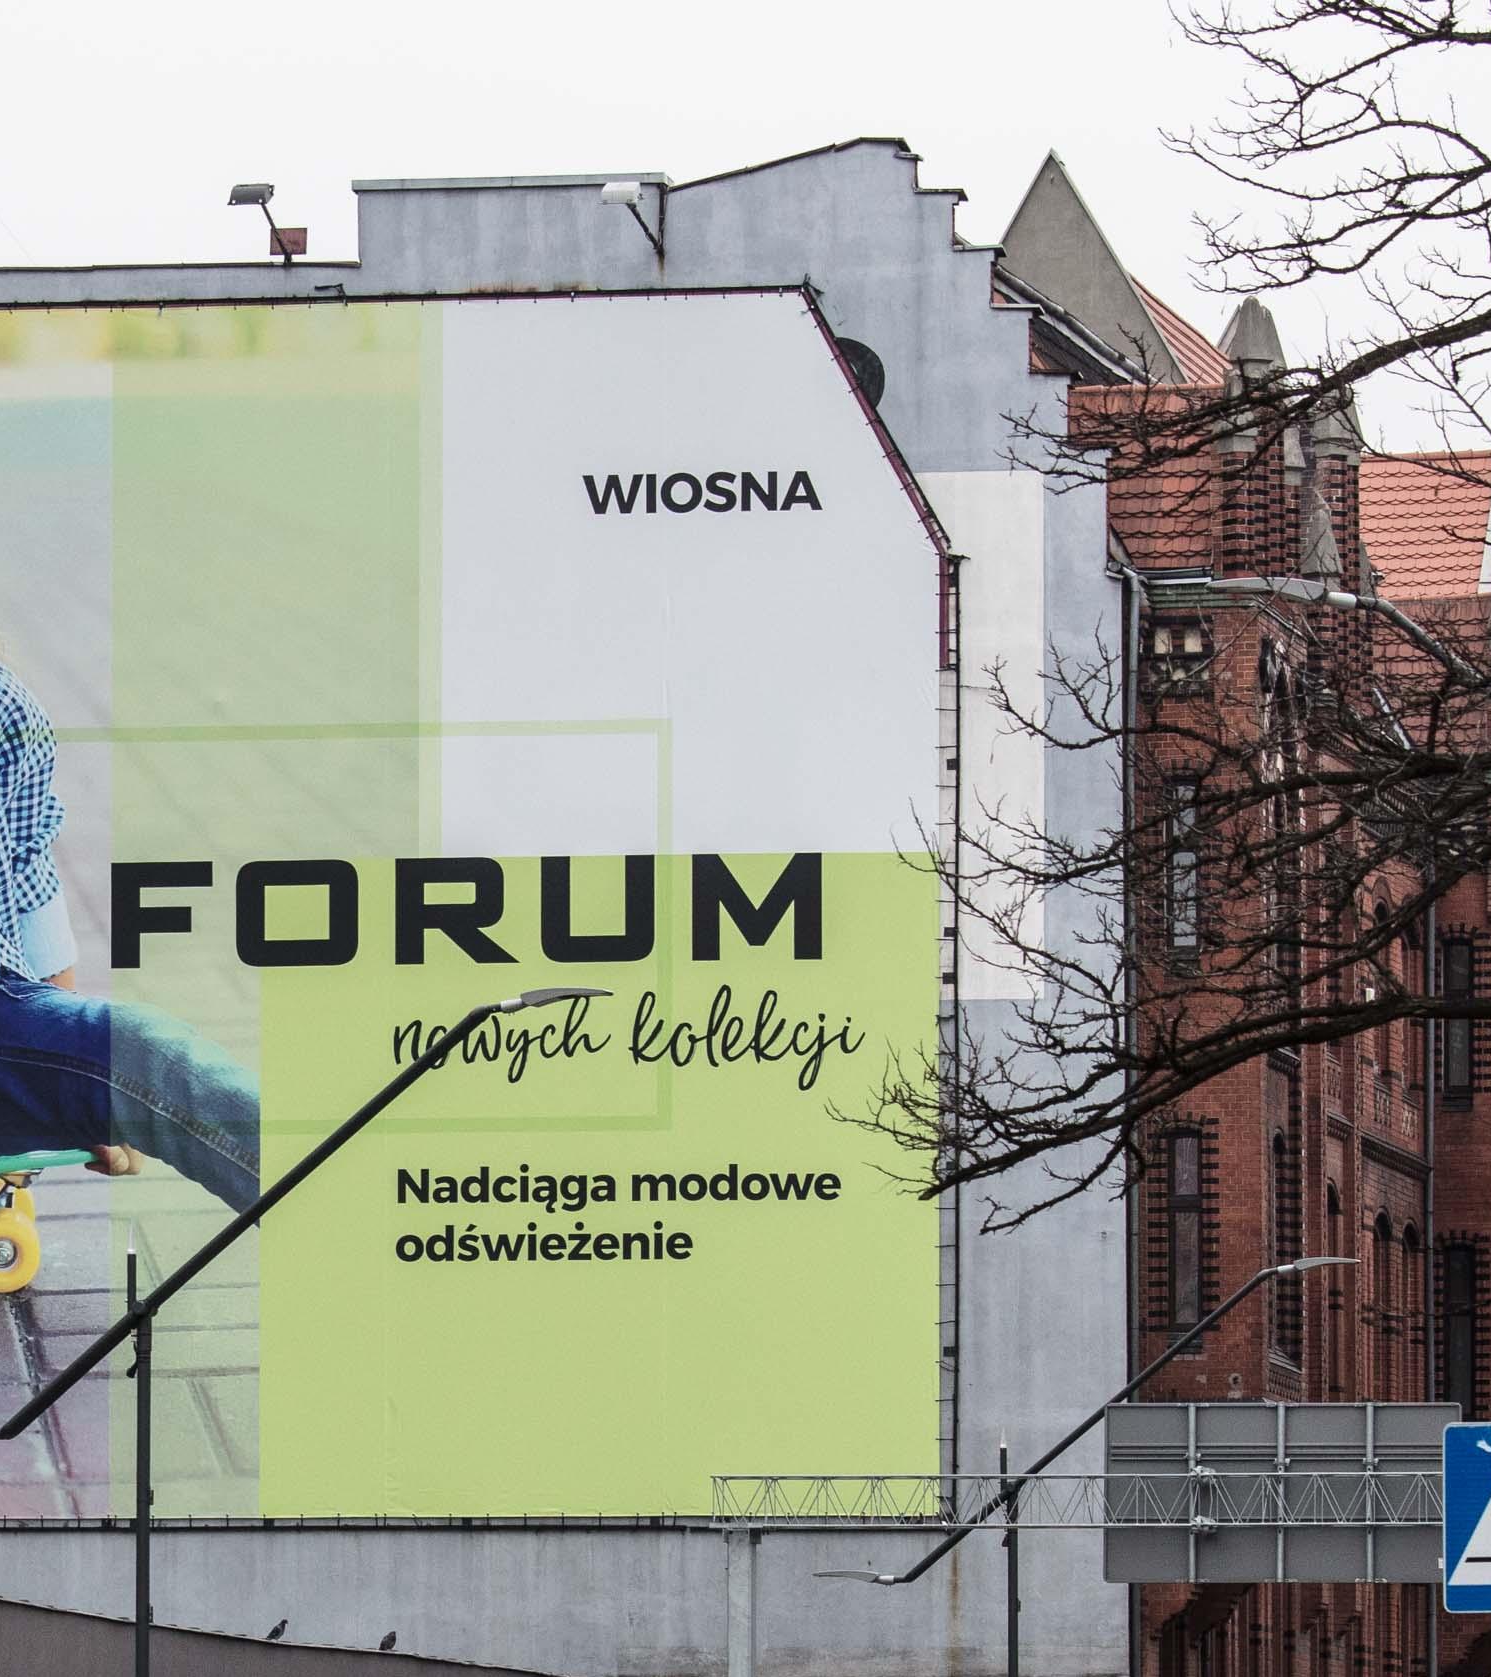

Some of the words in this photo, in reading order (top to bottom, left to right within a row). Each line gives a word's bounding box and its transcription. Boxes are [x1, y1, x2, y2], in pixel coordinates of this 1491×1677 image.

[582, 470, 823, 515] WIOSNA
[110, 852, 823, 969] FORUM
[391, 994, 613, 1084] nowych
[628, 983, 866, 1091] kolekcji
[396, 1163, 617, 1214] Nadciąga
[631, 1163, 842, 1201] modowe
[395, 1220, 694, 1263] odświeżenie
